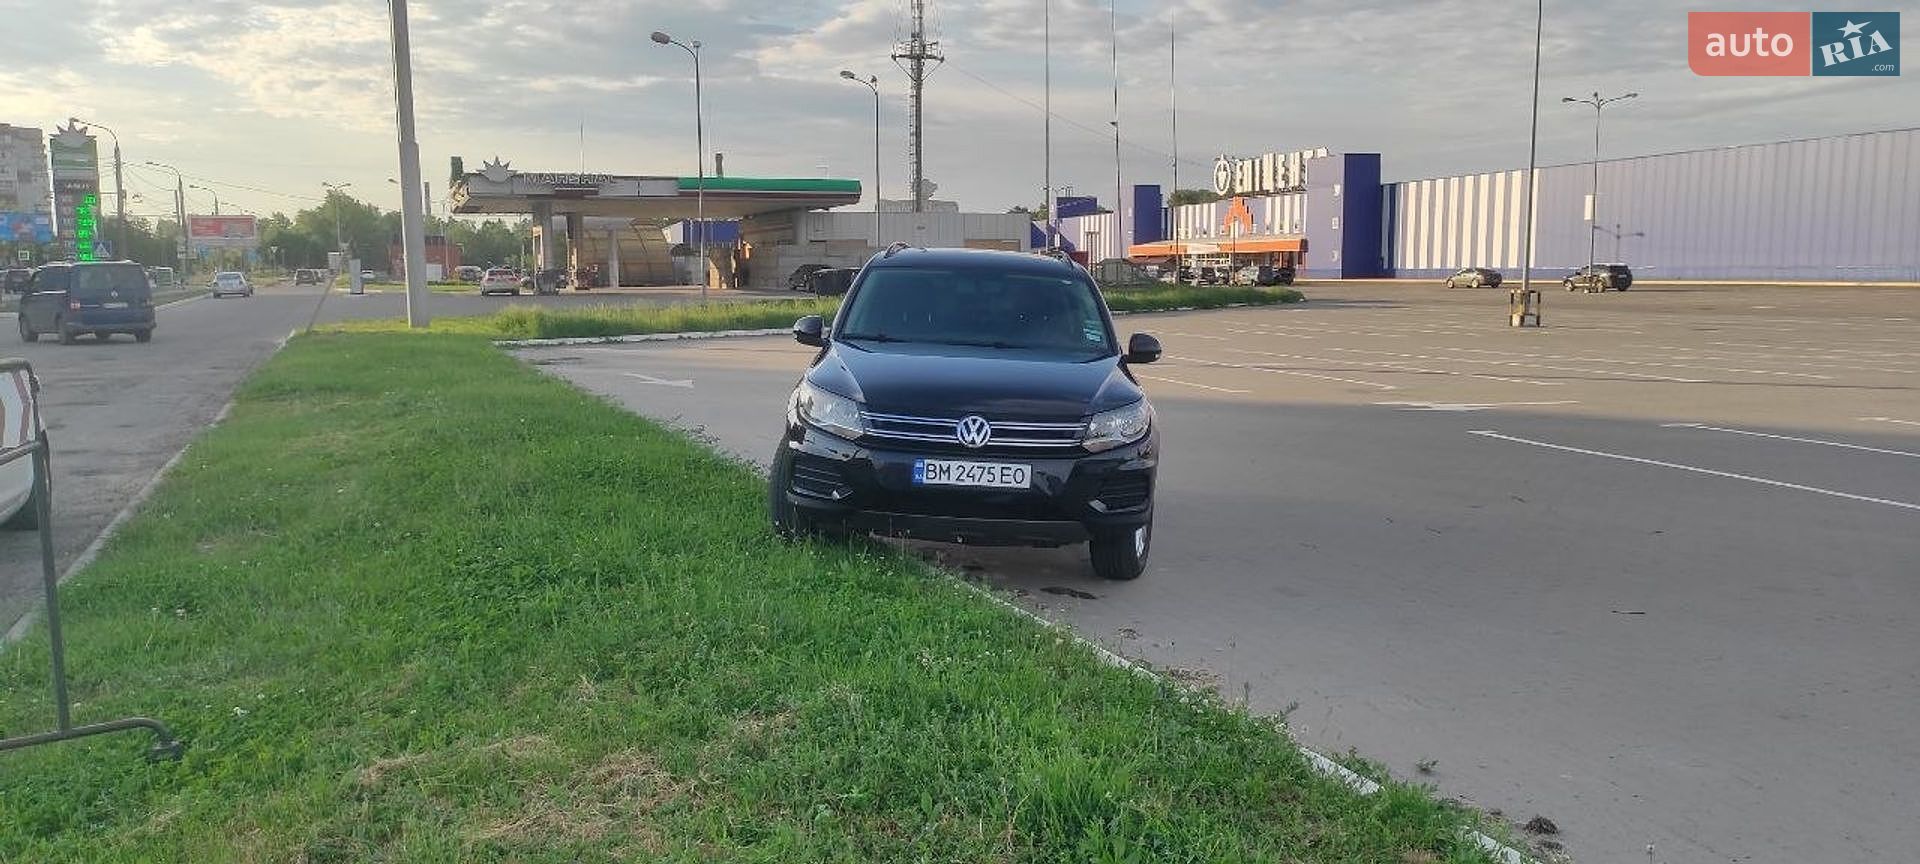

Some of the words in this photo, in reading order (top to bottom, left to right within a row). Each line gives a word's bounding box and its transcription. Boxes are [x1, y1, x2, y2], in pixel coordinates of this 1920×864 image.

[1234, 147, 1328, 193] ЕПІЦЕНТ
[925, 463, 951, 481] BM
[956, 465, 996, 483] 2475
[1000, 466, 1026, 485] EO
